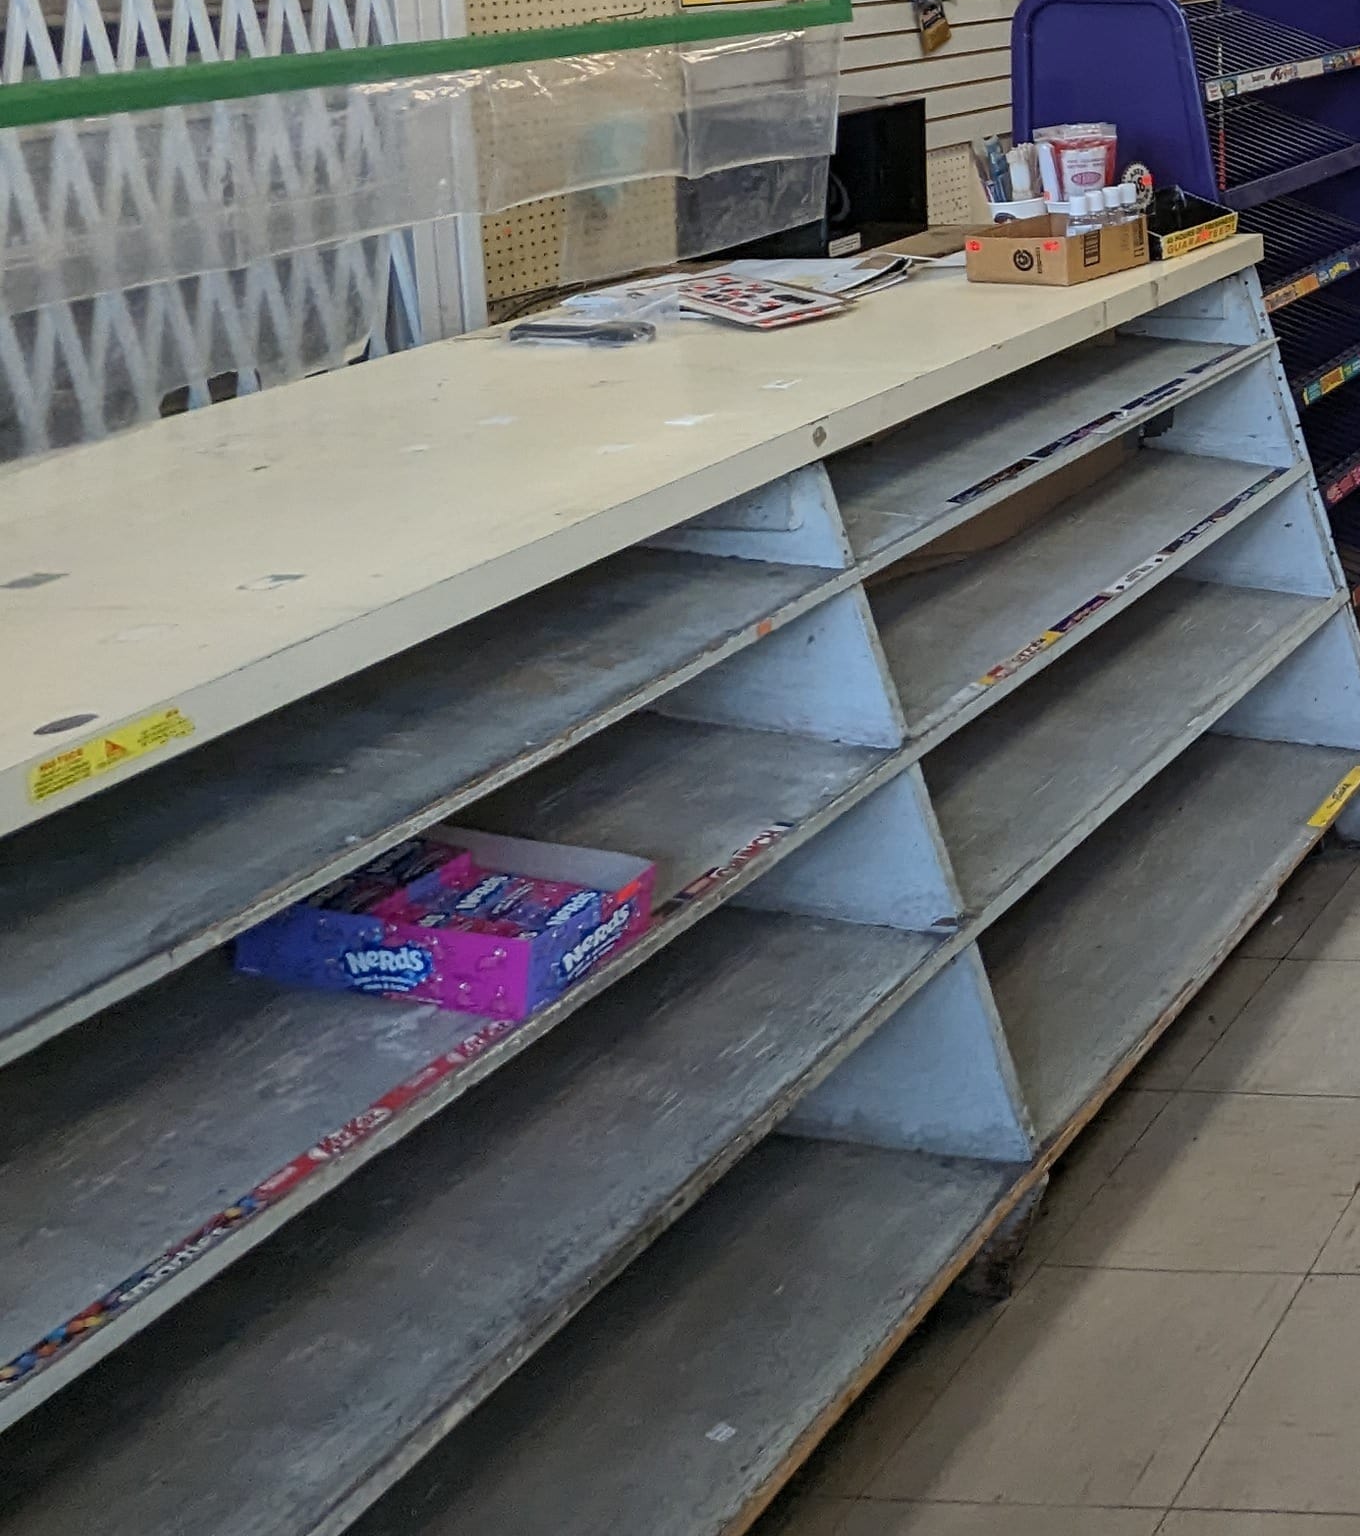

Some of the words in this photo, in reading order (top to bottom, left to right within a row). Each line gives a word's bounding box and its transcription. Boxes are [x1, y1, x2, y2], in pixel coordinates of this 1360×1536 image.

[1166, 223, 1236, 254] GUARATEED!
[546, 891, 598, 926] Nerds
[553, 903, 631, 973] Nerds
[345, 947, 424, 974] Nerds
[118, 1227, 232, 1302] smarties
